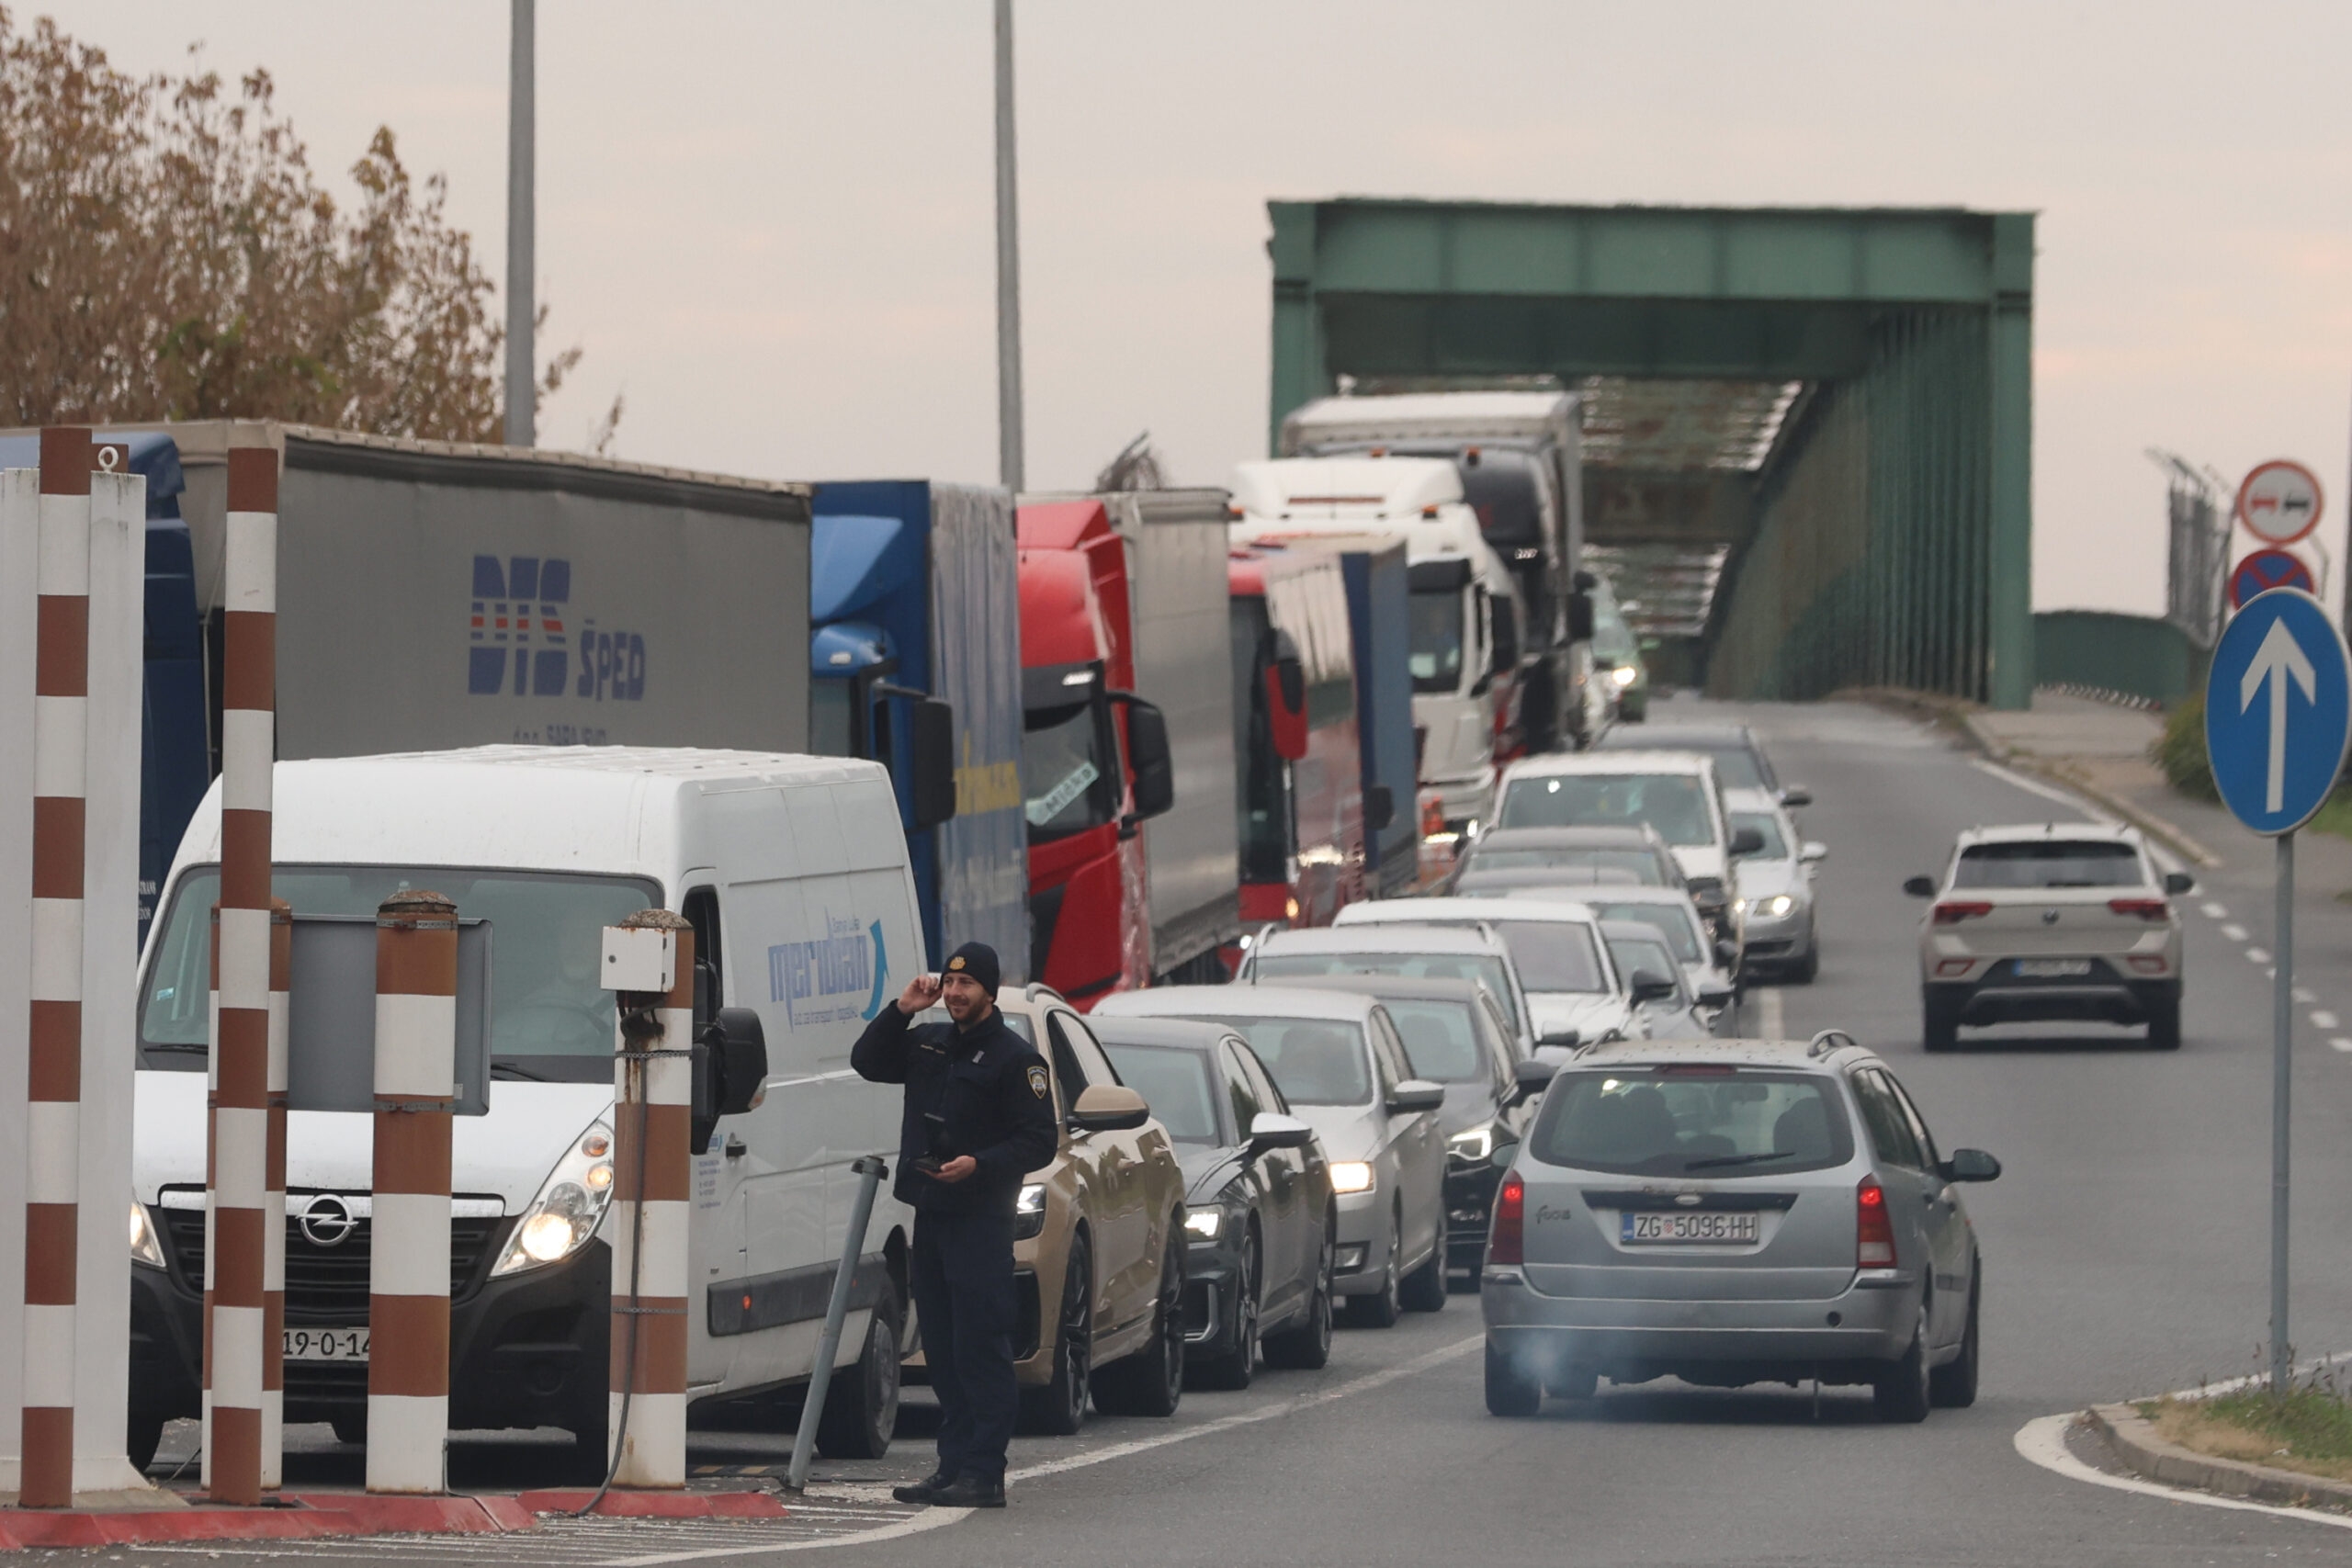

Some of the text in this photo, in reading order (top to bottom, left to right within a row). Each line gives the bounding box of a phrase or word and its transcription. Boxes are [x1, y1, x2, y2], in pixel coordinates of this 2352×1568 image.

[468, 555, 647, 702] DTS ŠPED
[768, 908, 869, 1033] meridian
[1636, 1215, 1756, 1239] ZG 5096-HH
